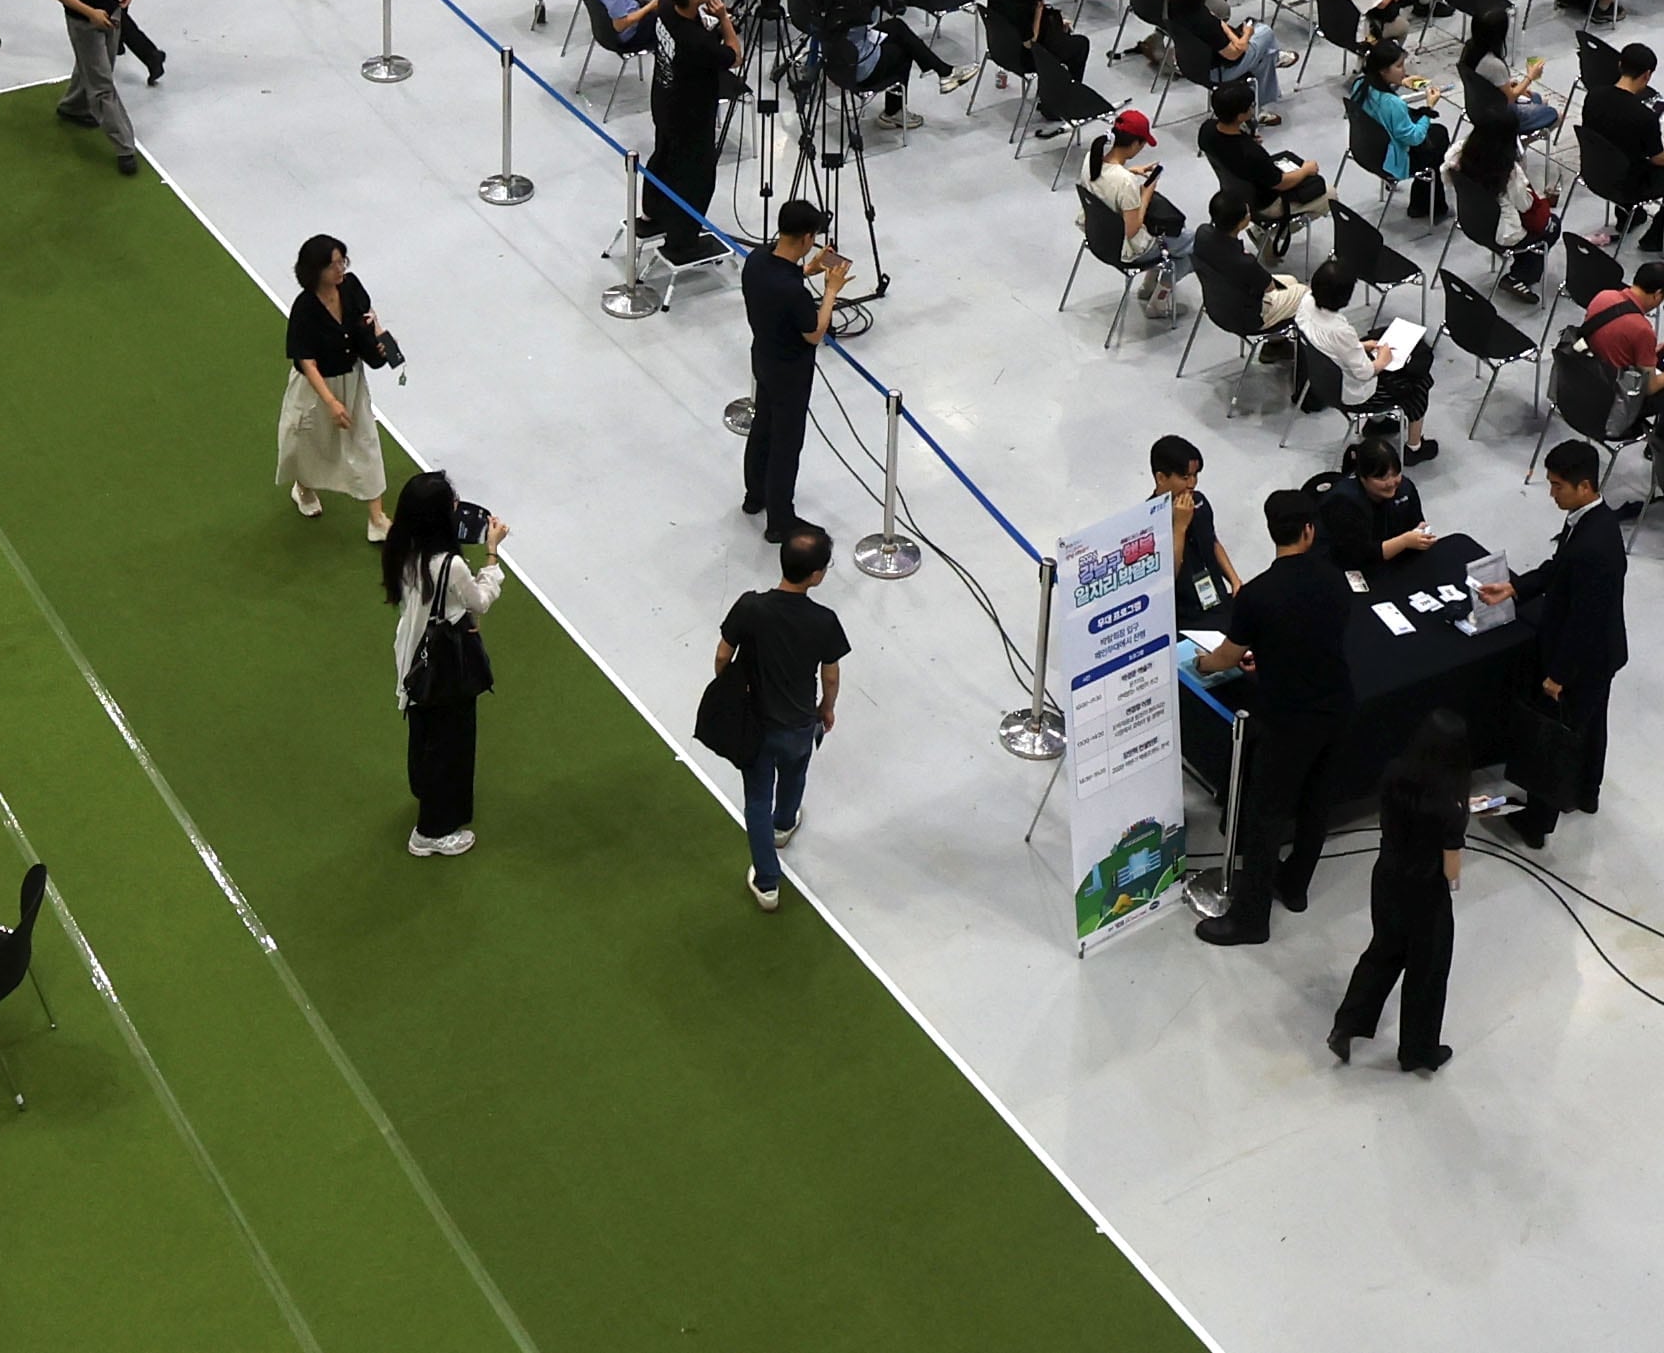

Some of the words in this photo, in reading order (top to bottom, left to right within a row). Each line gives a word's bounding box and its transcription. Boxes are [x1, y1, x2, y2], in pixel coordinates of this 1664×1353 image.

[1074, 572, 1118, 608] 일자리
[1116, 551, 1161, 585] 박람회
[1079, 549, 1123, 585] 강남구
